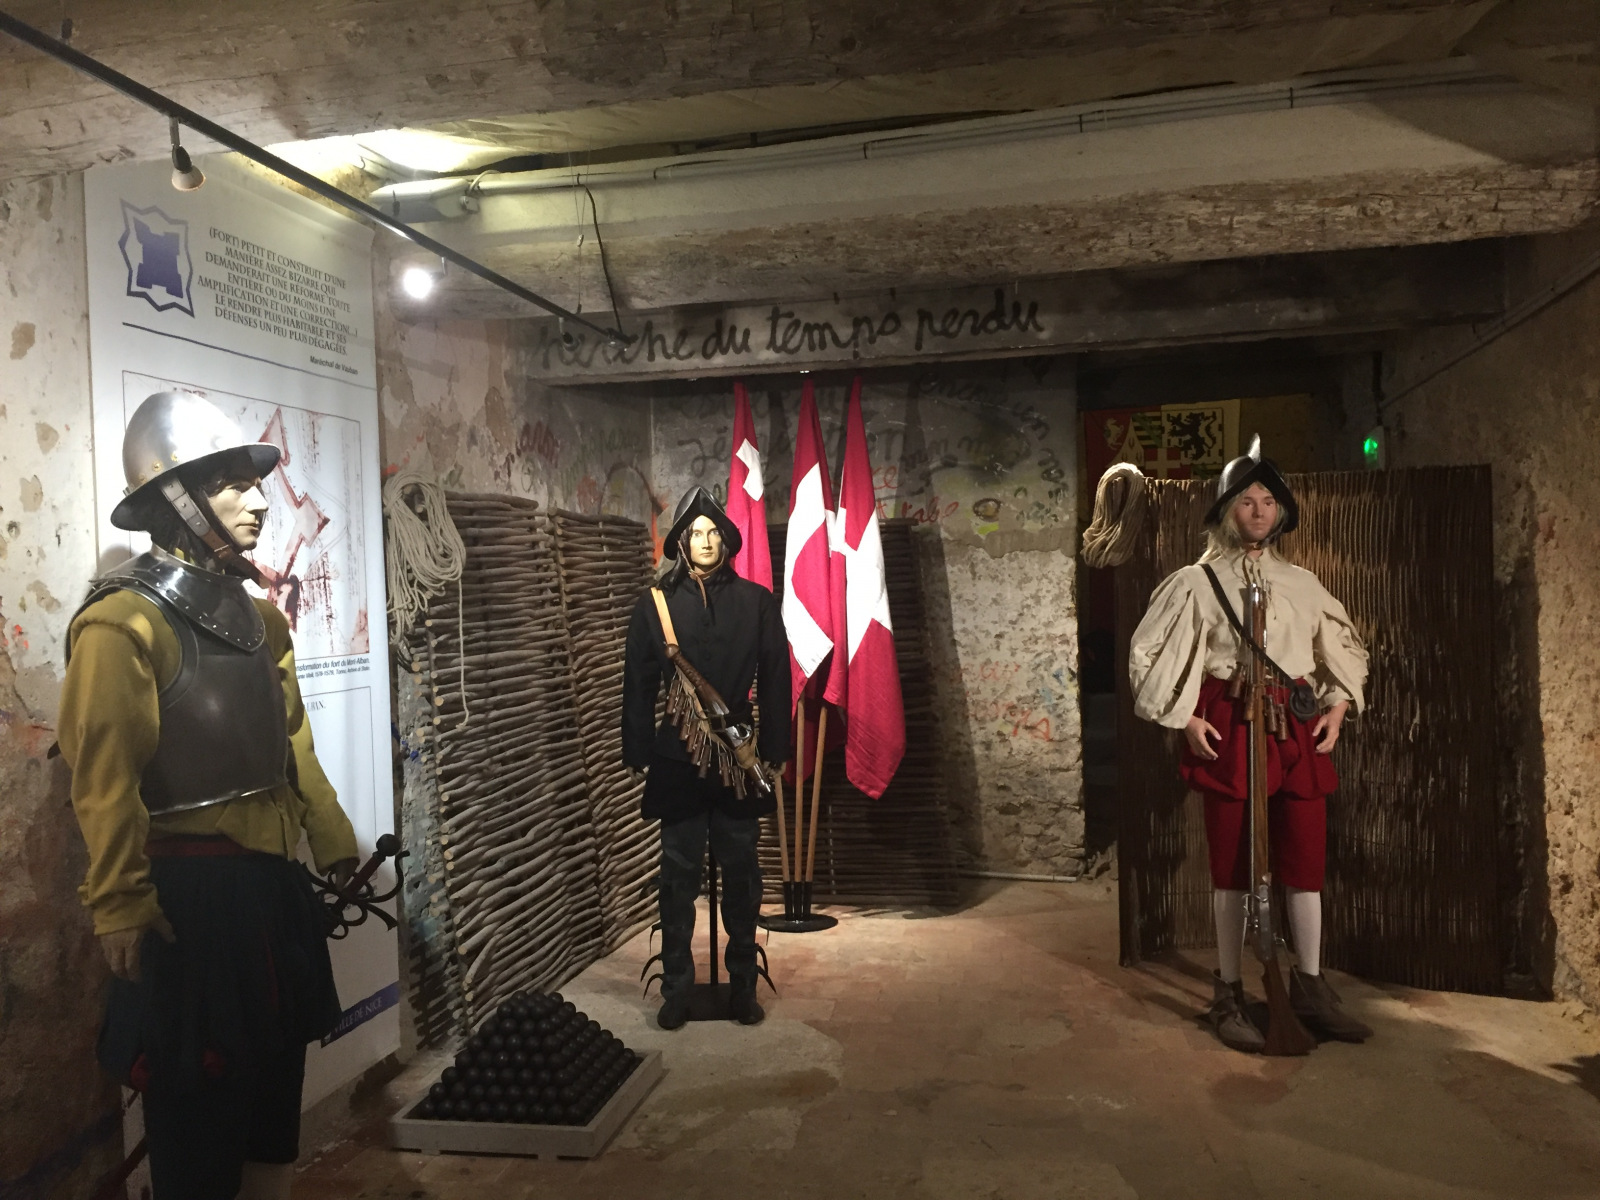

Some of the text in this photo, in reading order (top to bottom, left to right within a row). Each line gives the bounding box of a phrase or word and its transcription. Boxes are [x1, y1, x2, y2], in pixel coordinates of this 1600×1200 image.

[241, 239, 266, 257] PETIT
[267, 249, 276, 262] ET
[277, 254, 323, 280] CONSTRUIT
[266, 262, 288, 279] ASSEZ
[289, 270, 319, 291] BIZARRE
[321, 283, 336, 298] QUI
[198, 275, 269, 308] AMPLIFICATION
[270, 299, 280, 311] ET
[281, 303, 298, 318] UNE
[205, 251, 271, 284] DEMANDERAIT
[272, 275, 288, 291] UNE
[329, 296, 351, 313] TOUTE
[265, 286, 278, 299] OU
[279, 291, 291, 304] DU
[293, 295, 319, 313] MOINS
[320, 305, 336, 319] UNE
[215, 293, 347, 345] LE RENDRE PLUS HABITABLE ET SES
[260, 320, 272, 333] UN
[273, 325, 288, 339] PEU
[289, 329, 308, 344] PLUS
[702, 318, 751, 361] du
[915, 288, 1045, 351] perdu
